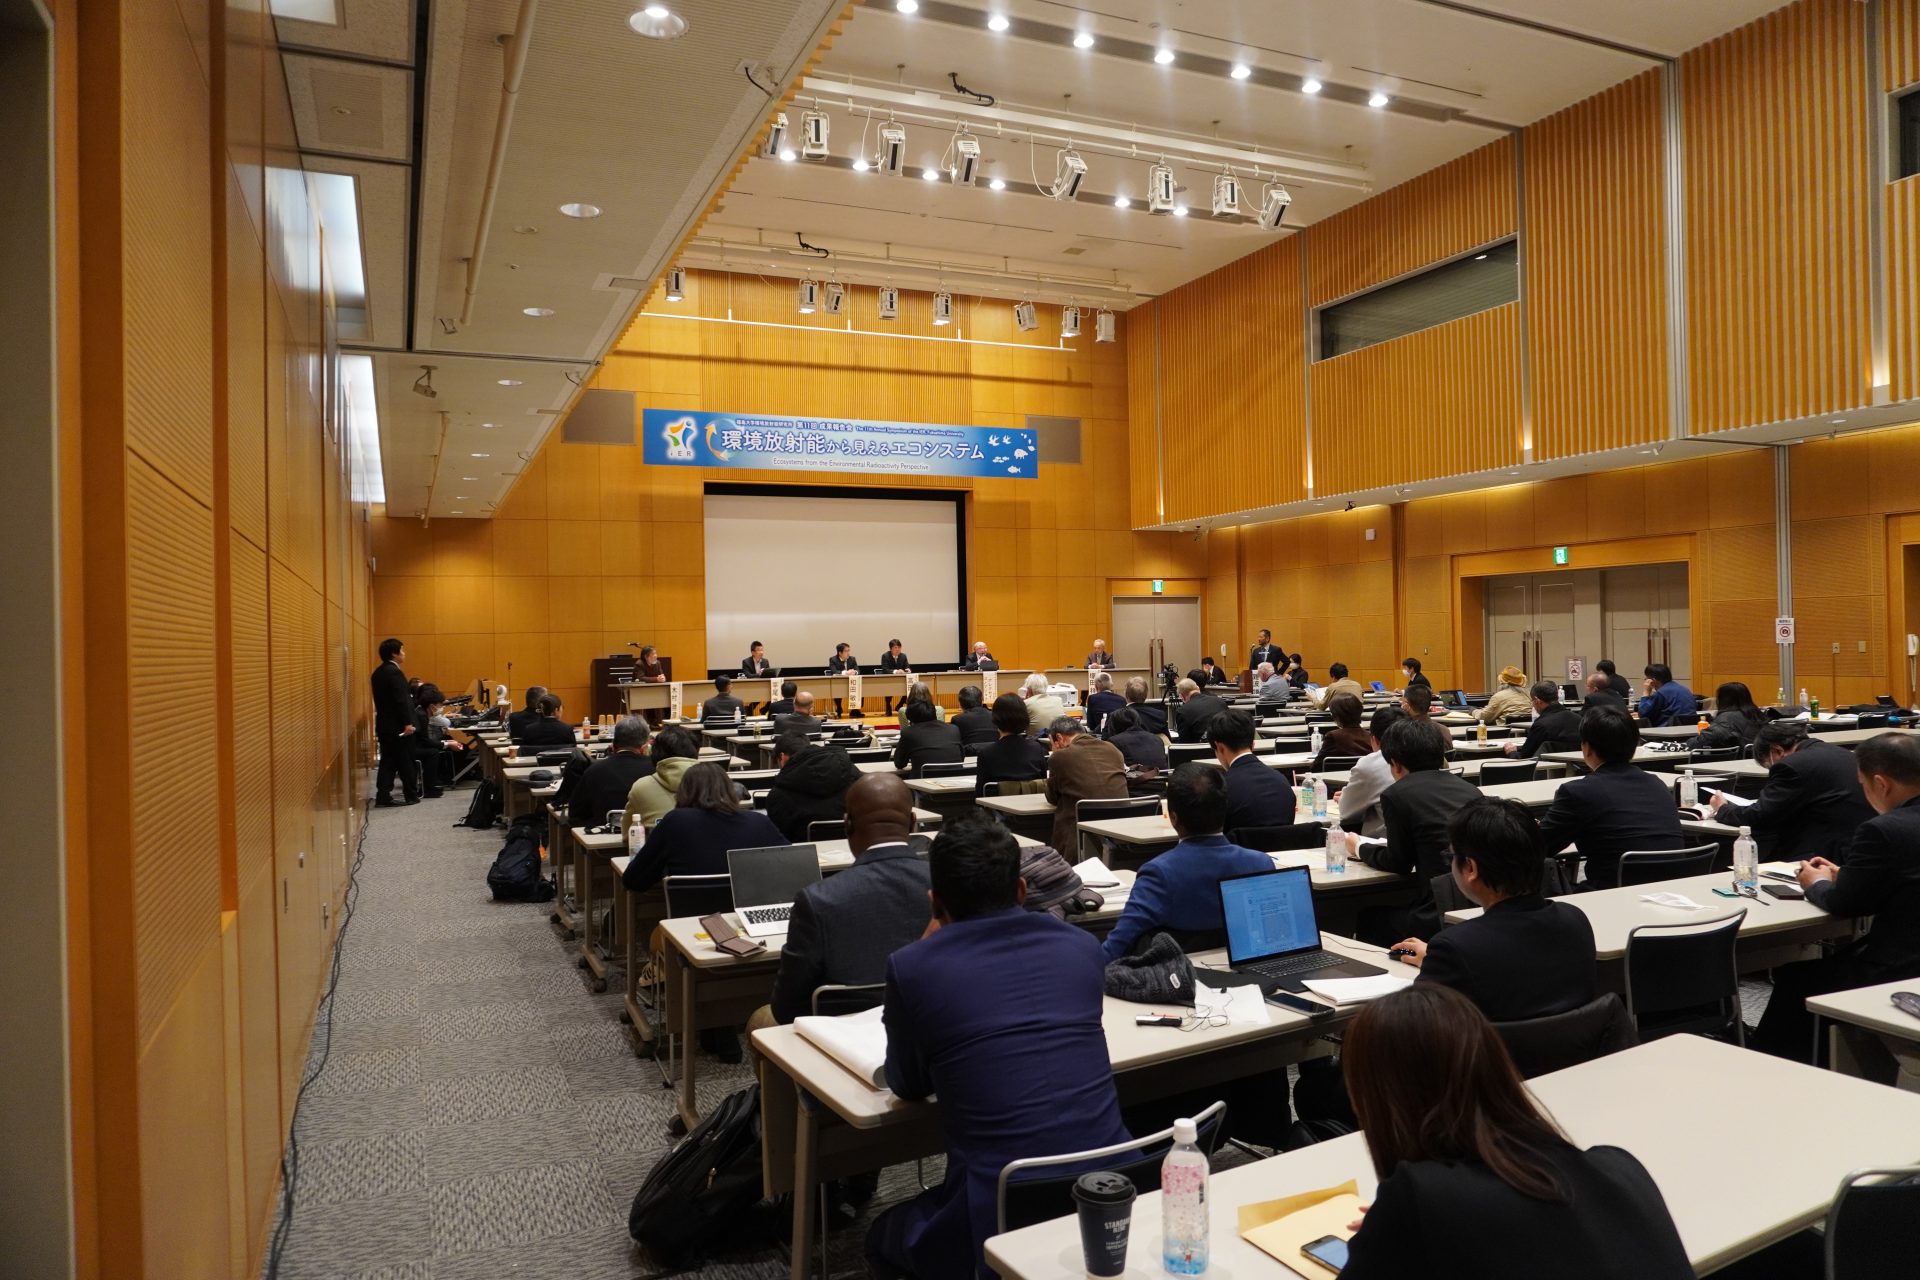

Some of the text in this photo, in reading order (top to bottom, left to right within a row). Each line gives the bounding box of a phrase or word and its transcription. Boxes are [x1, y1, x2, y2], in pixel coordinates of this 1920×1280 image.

[796, 421, 818, 430] 第11回
[722, 431, 985, 460] 環境放射能から見えるエコシステム
[773, 457, 804, 466] Ecosystems
[829, 460, 866, 468] Environmental
[866, 461, 899, 470] Radioactivity
[900, 462, 929, 471] Perspective
